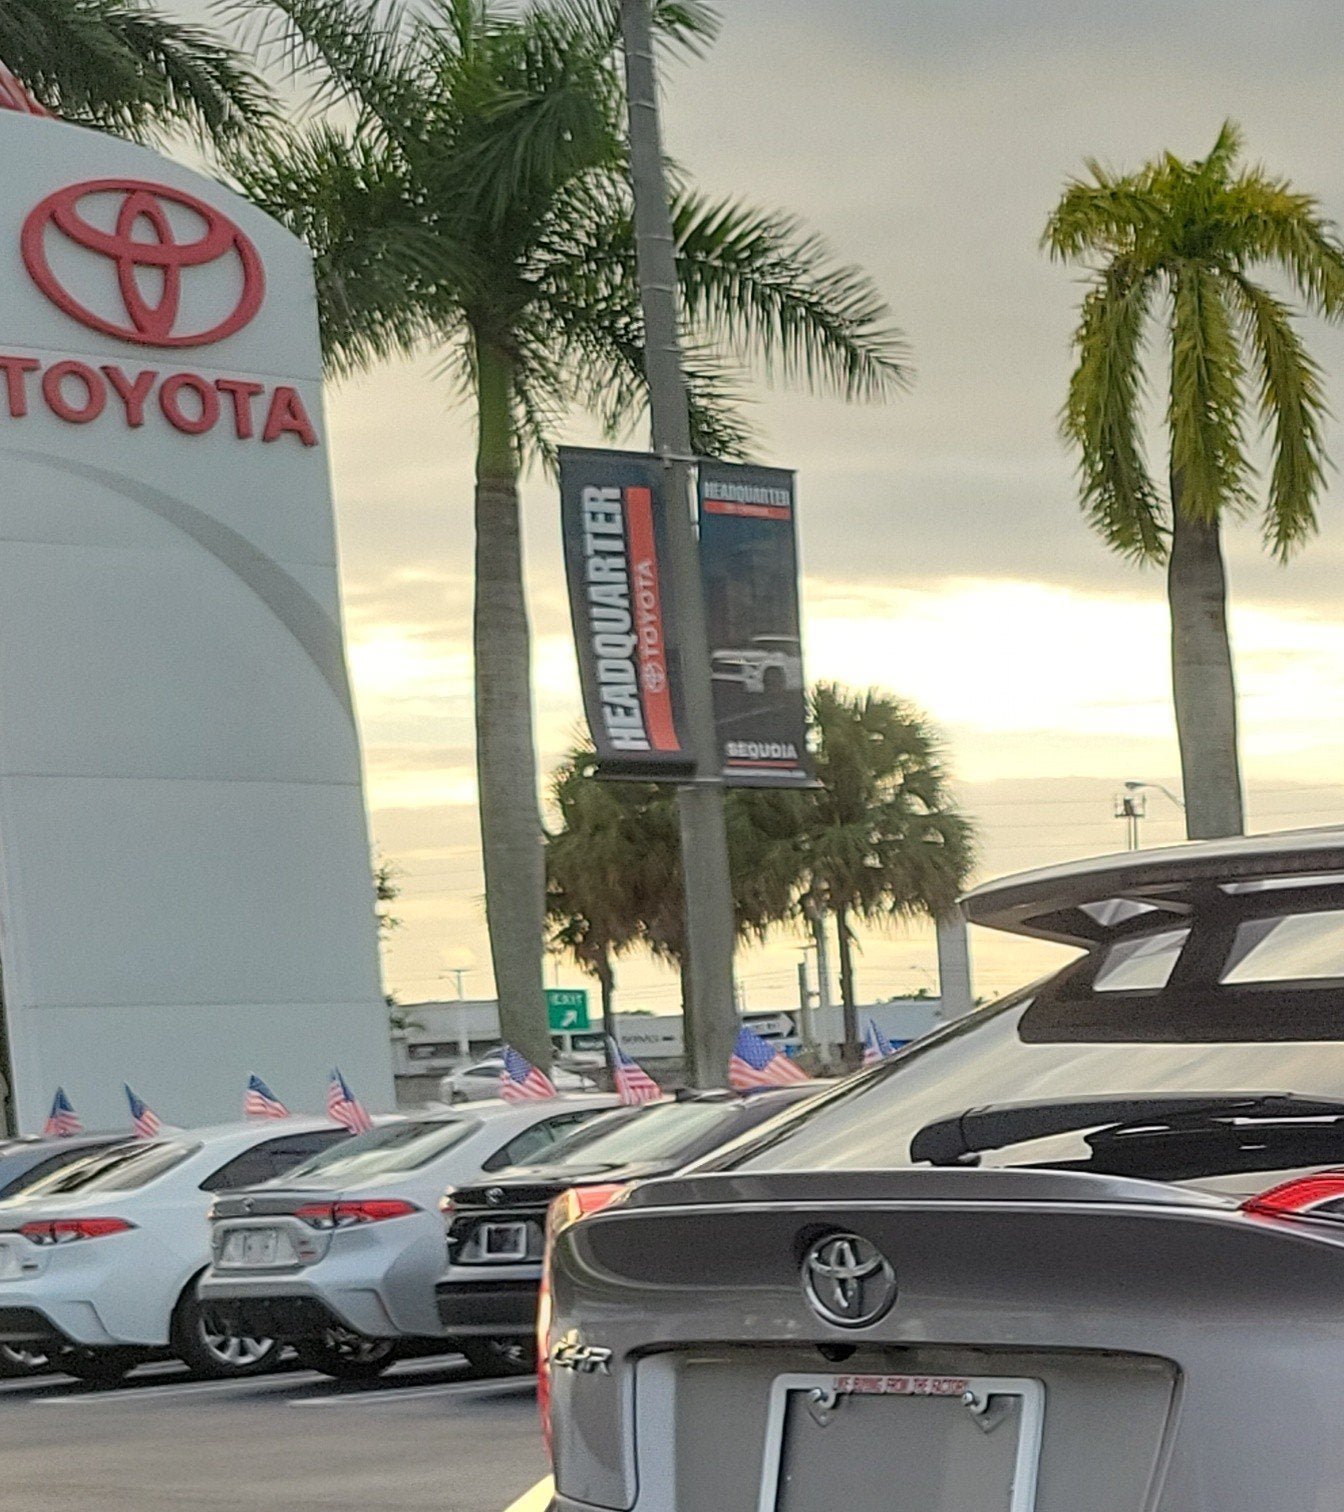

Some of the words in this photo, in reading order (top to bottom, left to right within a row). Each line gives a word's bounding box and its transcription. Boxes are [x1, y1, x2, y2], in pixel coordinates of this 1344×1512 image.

[0, 356, 319, 447] TOYOTA
[581, 485, 650, 750] HEADQUARTER
[635, 560, 664, 656] TOYOTA
[727, 741, 798, 759] SEQUOIA
